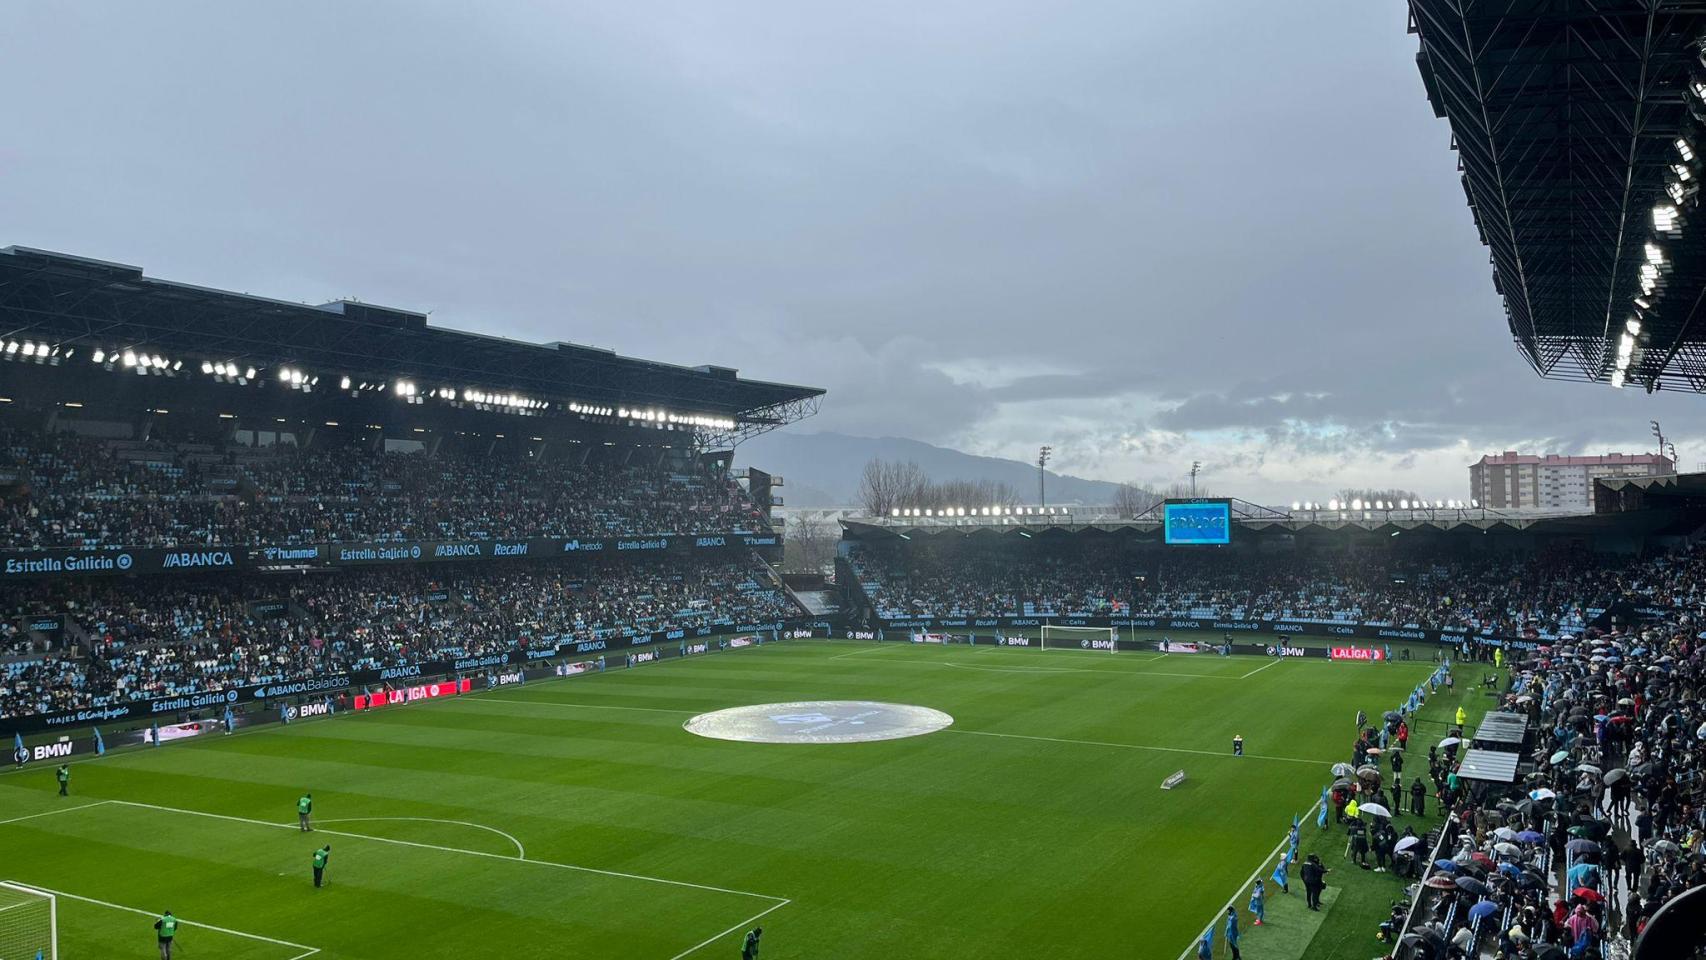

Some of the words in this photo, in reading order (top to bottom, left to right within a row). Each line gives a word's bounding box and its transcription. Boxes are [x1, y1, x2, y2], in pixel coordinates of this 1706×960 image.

[494, 543, 528, 555] Recalvi
[617, 541, 640, 550] Estrella
[640, 540, 660, 549] Galicia
[278, 547, 318, 560] hummel
[340, 548, 376, 560] Estrella
[378, 547, 409, 560] Galicia
[5, 558, 61, 573] Estrella
[64, 555, 113, 571] Galicia
[793, 630, 812, 639] BMW
[855, 632, 874, 640] BMW
[1336, 626, 1353, 634] Celta
[1008, 637, 1029, 646] BMW
[1092, 640, 1114, 649] BMW
[638, 651, 653, 662] BMW
[1333, 647, 1369, 659] LALIGA
[455, 660, 478, 669] Estrella
[479, 655, 500, 665] Galicia
[500, 673, 520, 684] BMW
[389, 686, 427, 703] LAIGA
[152, 699, 190, 712] Estrella
[191, 694, 225, 707] Galicia
[300, 703, 328, 717] BMW
[46, 715, 75, 725] VIAJES
[34, 741, 73, 760] BMW
